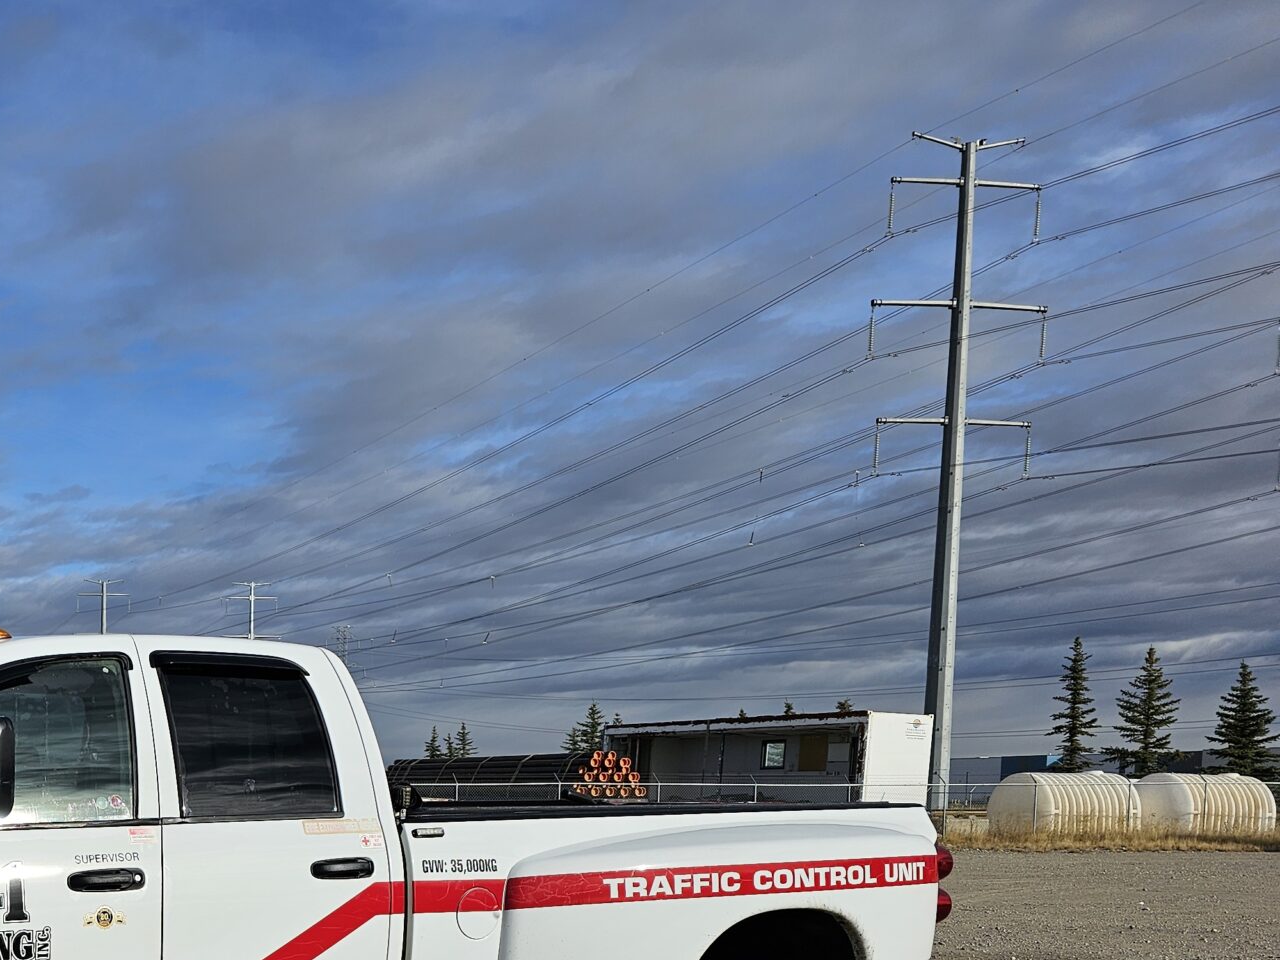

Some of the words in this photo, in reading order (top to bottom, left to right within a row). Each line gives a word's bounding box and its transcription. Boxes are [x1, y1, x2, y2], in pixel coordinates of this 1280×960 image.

[74, 852, 140, 864] SUPERVISOR
[422, 859, 447, 873] GVW:
[451, 858, 498, 874] 35,000KG
[604, 871, 740, 898] TRAFFIC
[753, 864, 877, 890] CONTROL
[885, 861, 926, 882] UNIT
[35, 926, 51, 960] INC.
